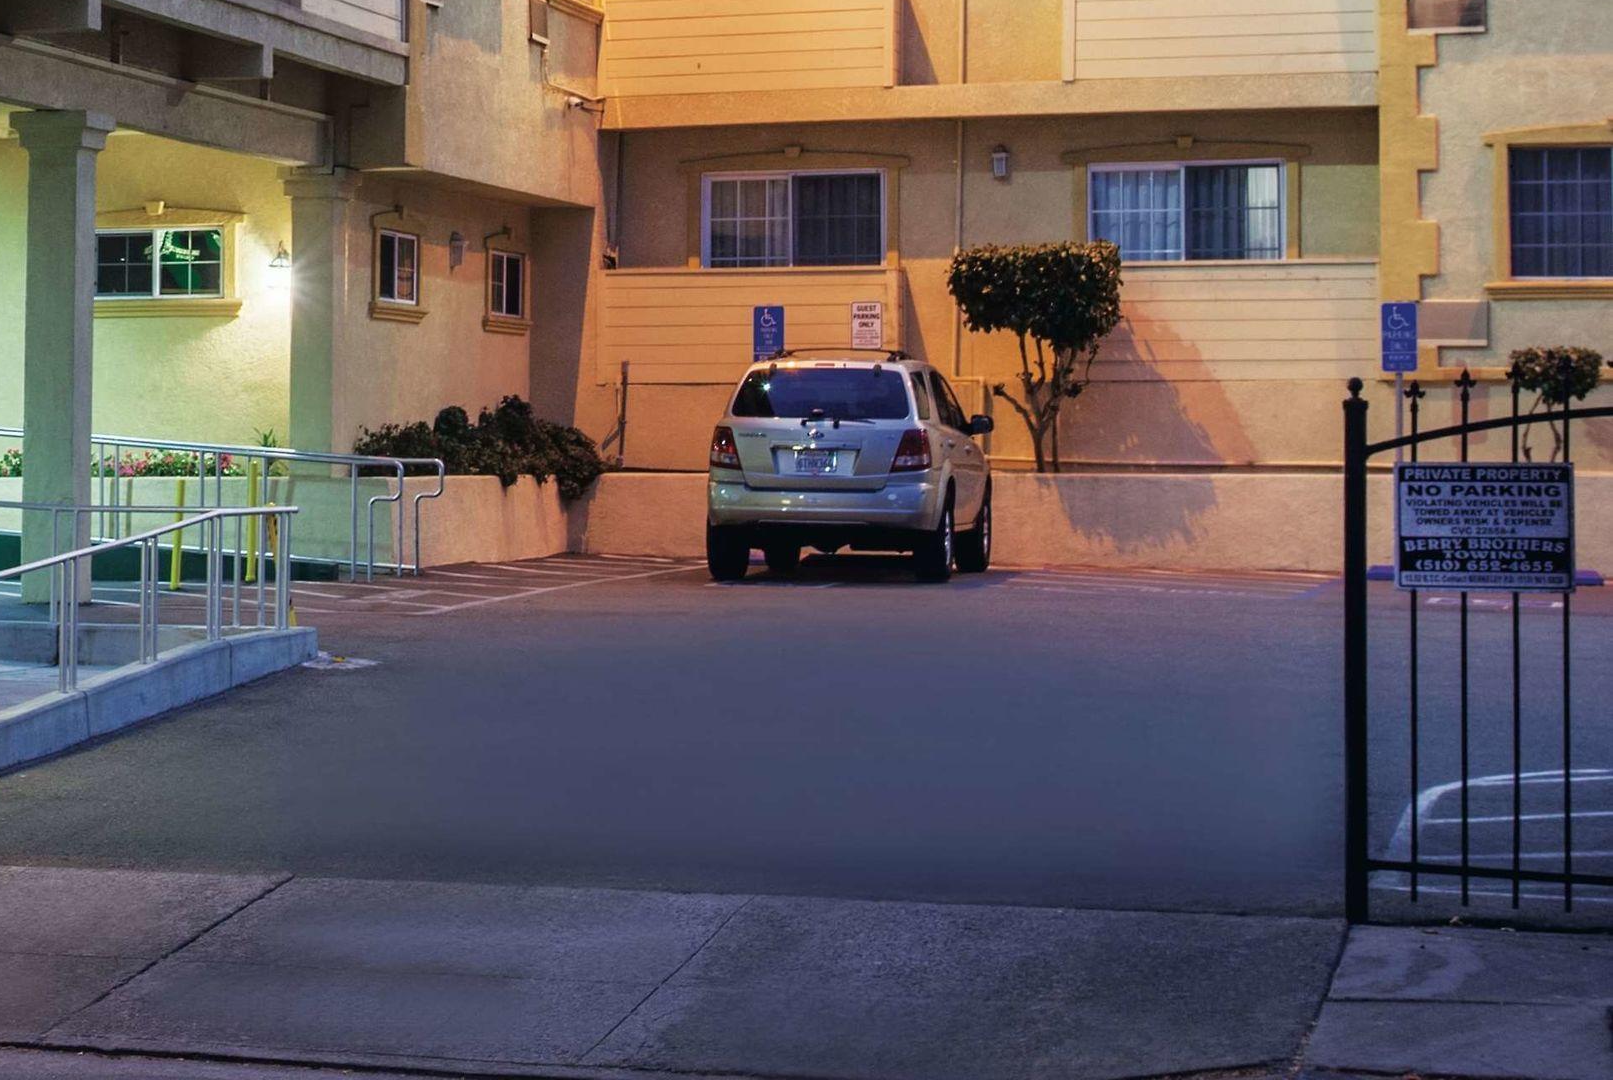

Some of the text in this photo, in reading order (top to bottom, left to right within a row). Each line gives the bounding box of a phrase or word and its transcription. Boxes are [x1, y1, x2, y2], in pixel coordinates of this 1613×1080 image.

[1404, 468, 1562, 481] PRIVATE PROPERTY
[1407, 485, 1562, 497] NO PARKING
[1405, 499, 1462, 507] VIOLATING
[1466, 499, 1518, 508] VEHICLES
[1520, 499, 1545, 508] WILL
[1414, 508, 1556, 517] TOWED AWAY AT VEHICLES
[1416, 517, 1553, 527] OWNERS RISK & EXPENSE
[1451, 526, 1473, 535] CVC
[1404, 538, 1566, 553] BERRY BROTHERS
[1442, 550, 1526, 560] TOWING
[1415, 559, 1554, 572] (510) 652-4655
